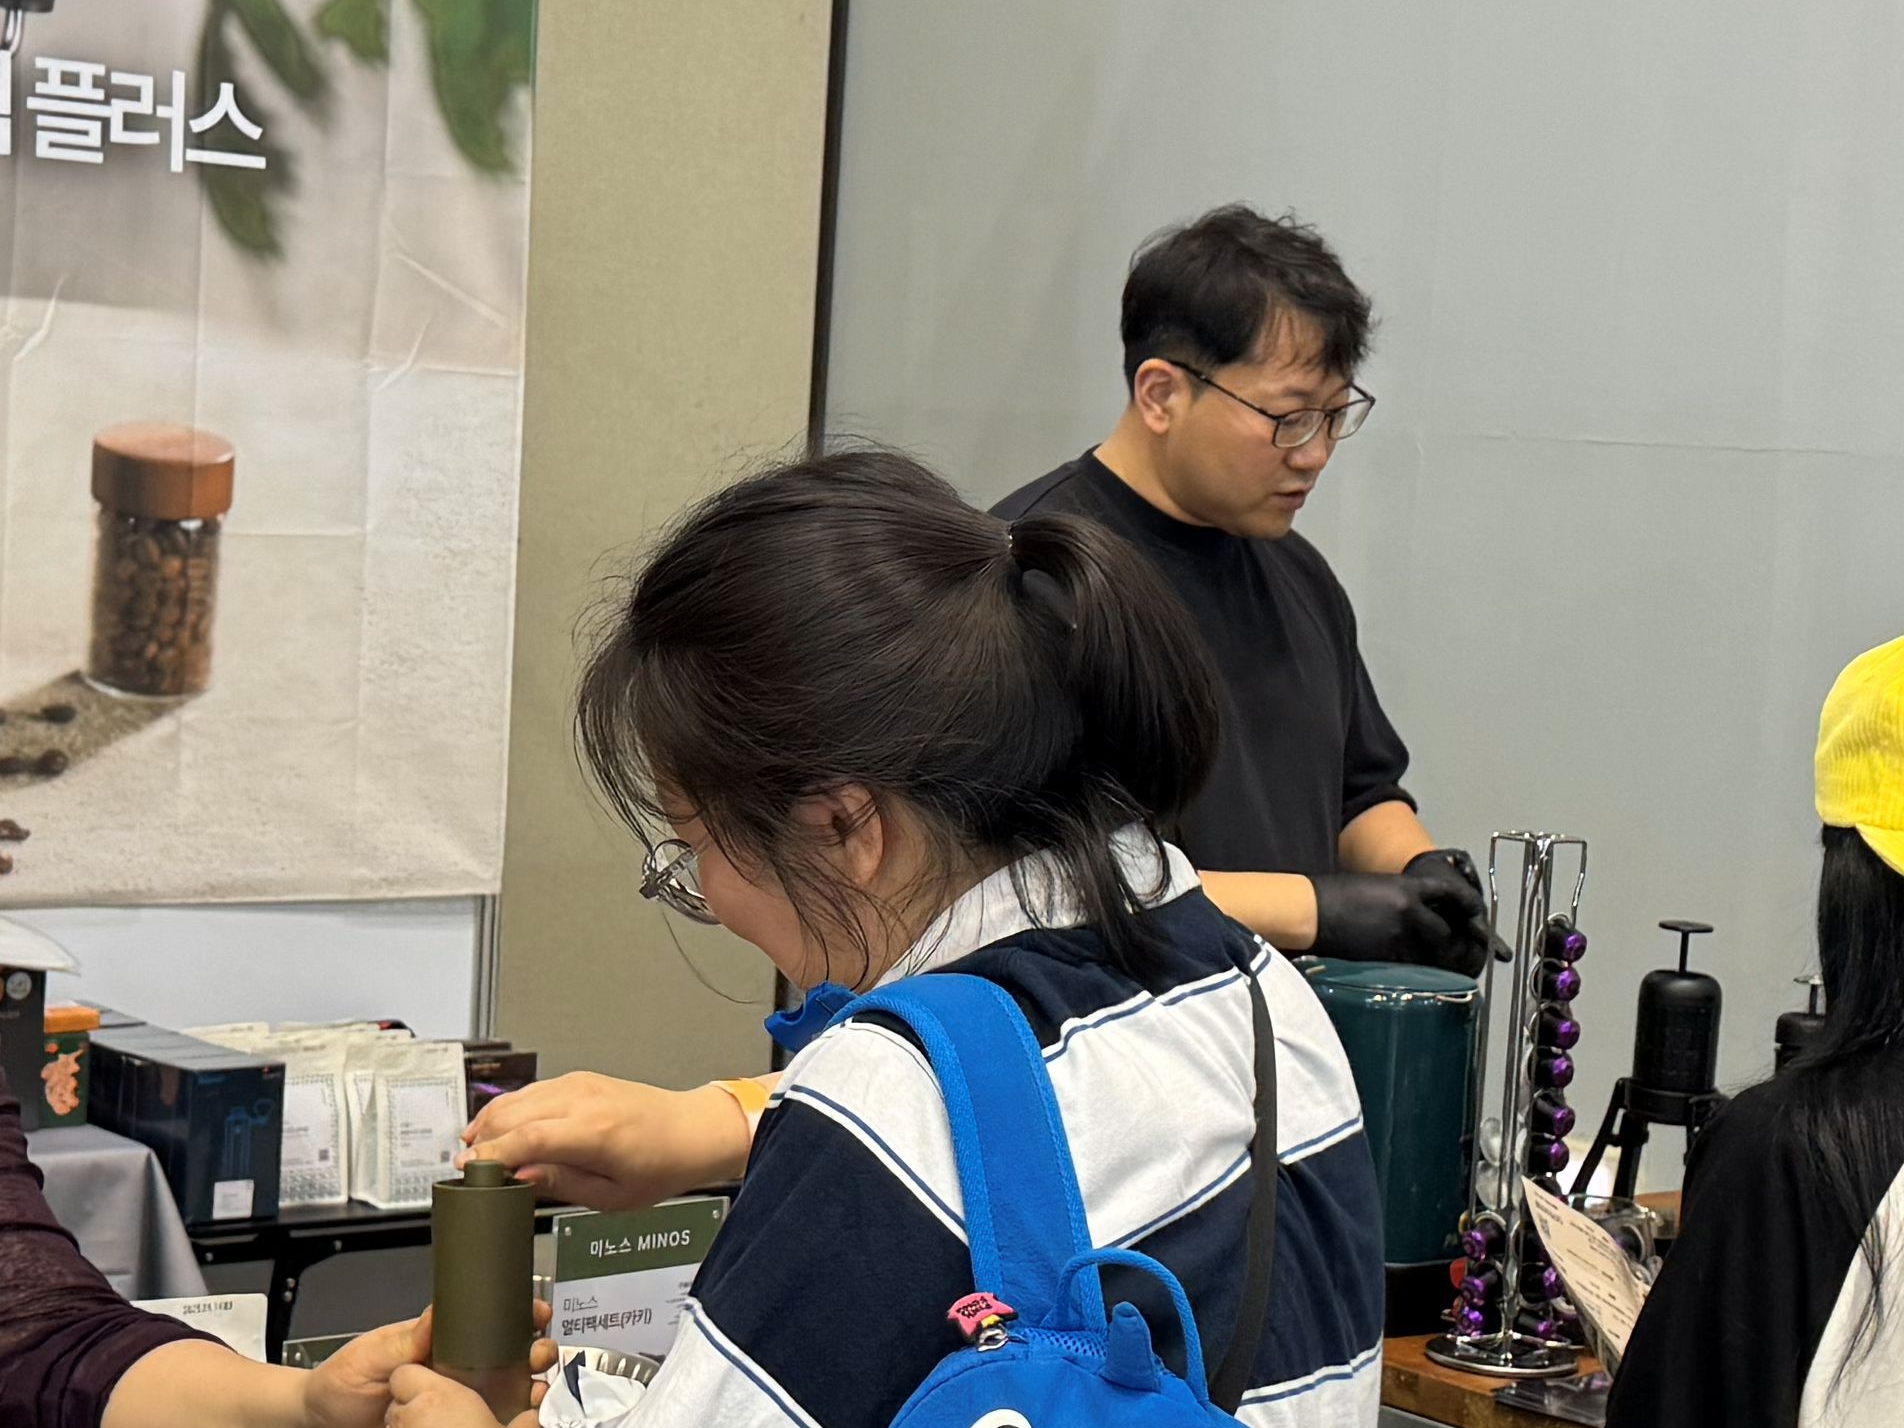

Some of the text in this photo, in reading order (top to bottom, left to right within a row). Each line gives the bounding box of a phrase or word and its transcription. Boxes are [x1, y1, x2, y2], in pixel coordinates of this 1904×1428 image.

[27, 48, 269, 173] 플러스
[590, 1229, 691, 1258] 미노스 MINOS
[563, 1297, 598, 1311] 미노스
[562, 1309, 652, 1336] 멀티팩세트(카키)
